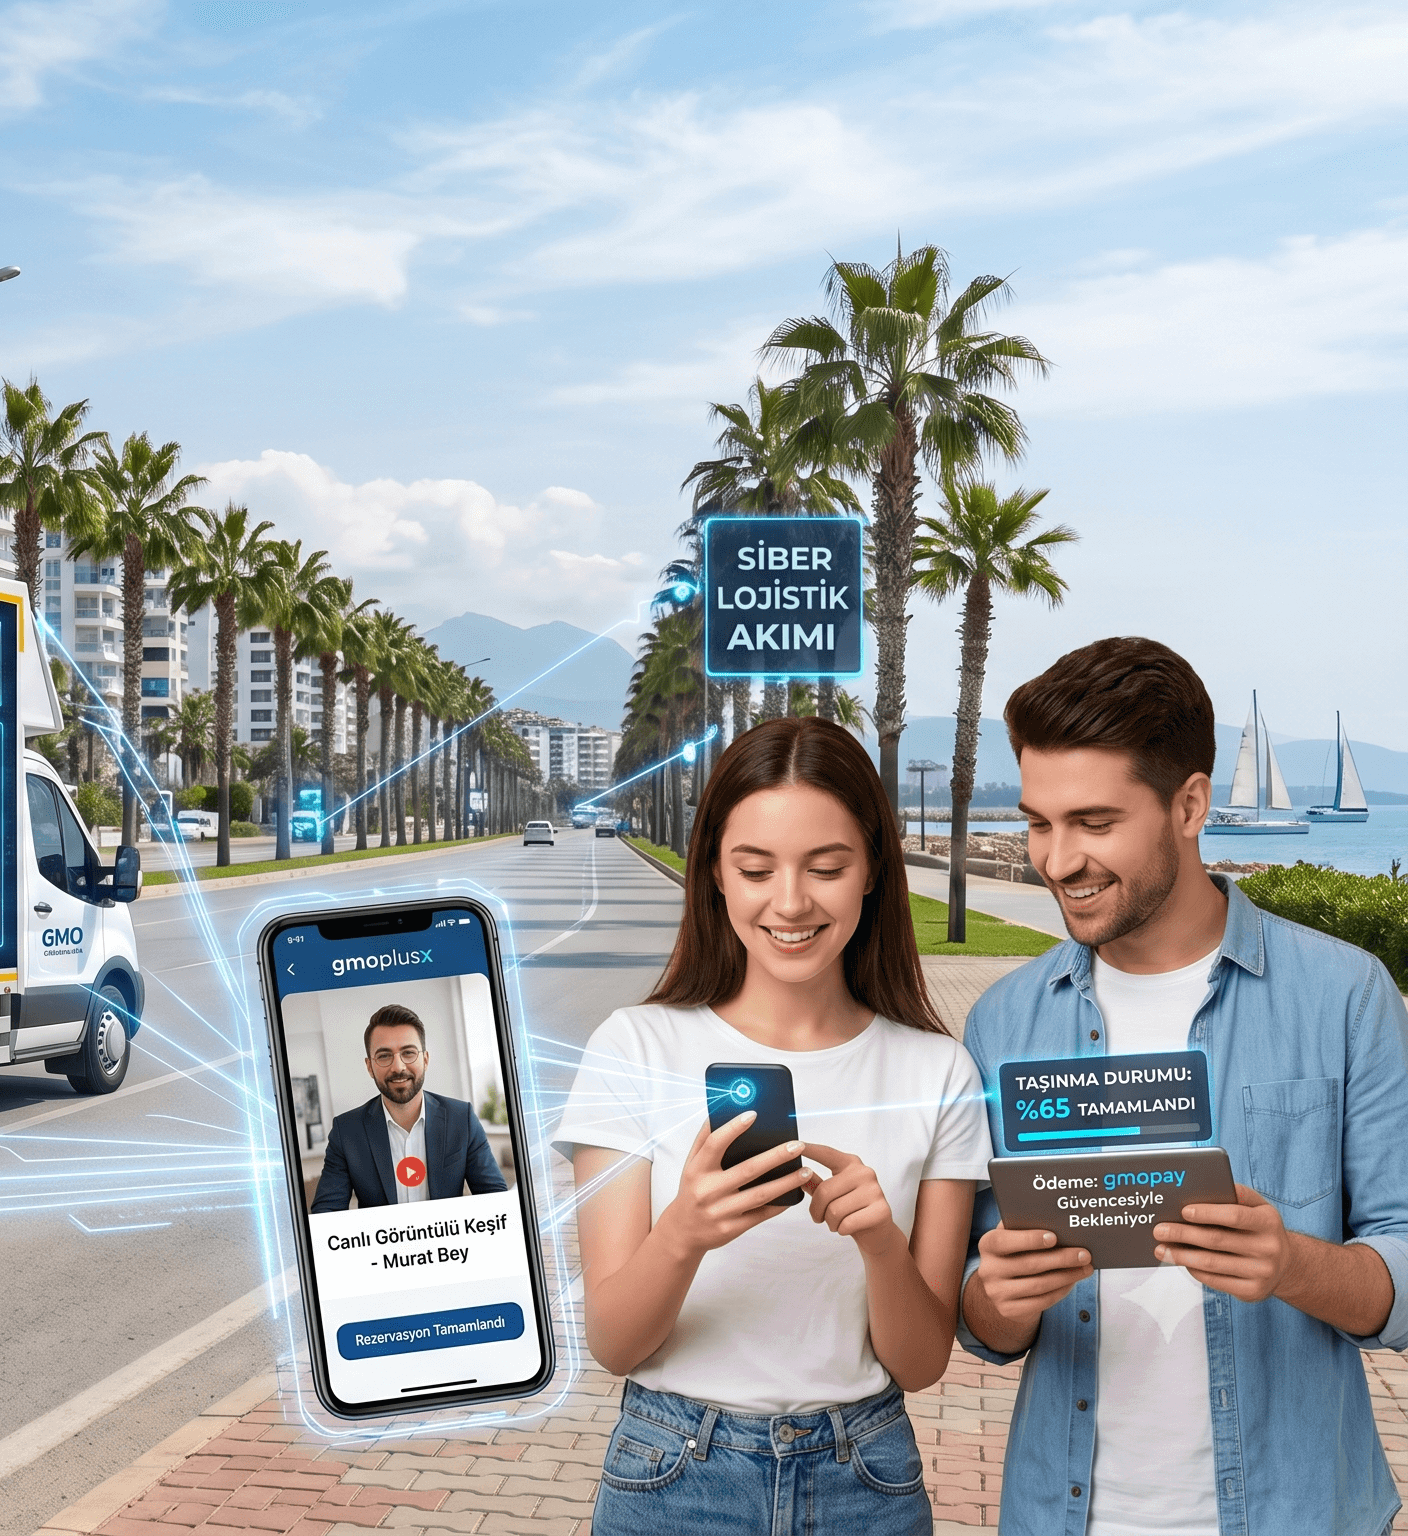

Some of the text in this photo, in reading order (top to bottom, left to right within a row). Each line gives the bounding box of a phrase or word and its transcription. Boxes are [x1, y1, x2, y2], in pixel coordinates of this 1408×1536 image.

[42, 926, 84, 947] GMO
[1015, 1067, 1192, 1093] TAŞINMA DURUMU:
[1015, 1097, 1196, 1120] %65 TAMAMLANDI
[1033, 1170, 1186, 1191] Ödeme: gmopay
[1057, 1191, 1164, 1210] Güvencesiyle
[1069, 1211, 1155, 1229] Bekleniyor
[327, 1214, 508, 1252] Canlı Görüntülü Keşif
[383, 1249, 434, 1269] Murat
[438, 1246, 469, 1264] Bey
[355, 1315, 506, 1347] Rezervasyon Tamamlandı
